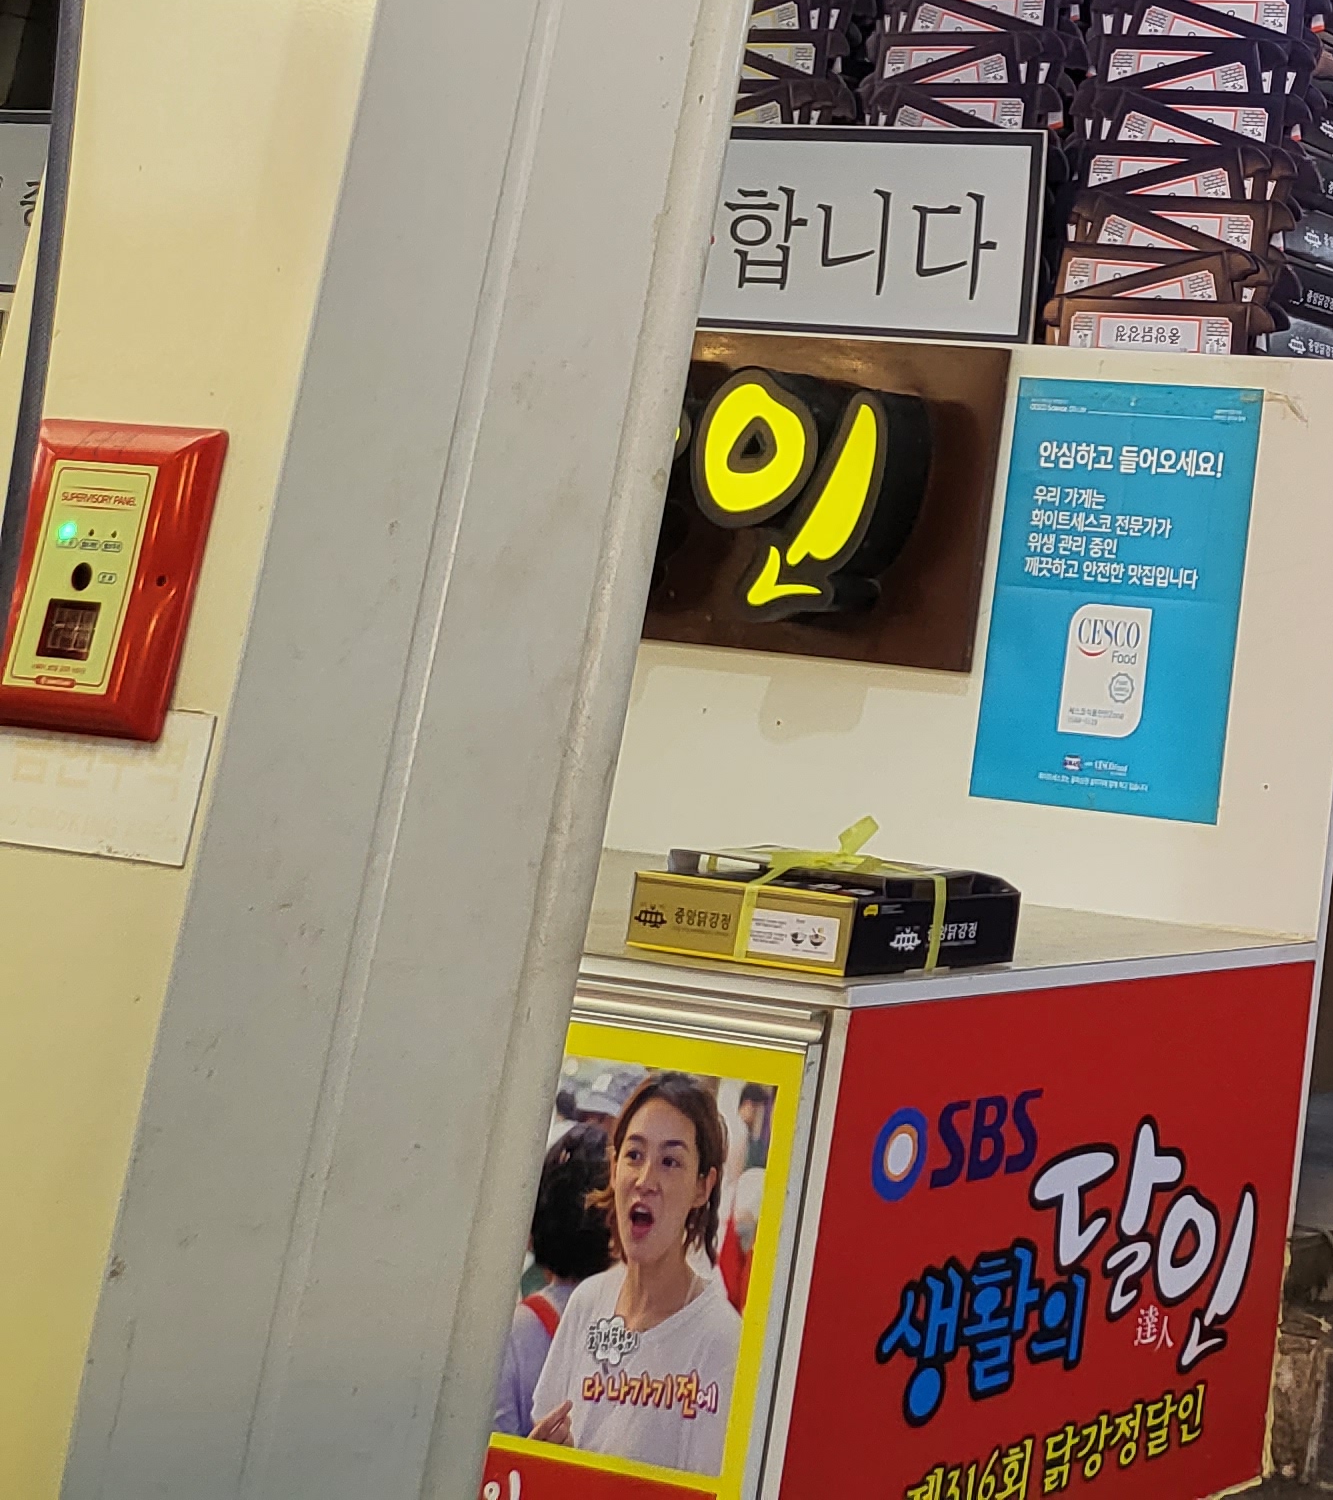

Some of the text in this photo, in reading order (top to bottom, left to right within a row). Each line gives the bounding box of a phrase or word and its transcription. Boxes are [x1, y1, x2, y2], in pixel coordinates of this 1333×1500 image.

[724, 184, 998, 300] 합니다
[1039, 441, 1224, 479] 안심하고 들어오세요!
[61, 491, 137, 507] SUPERVISORY PANEL
[1033, 485, 1106, 510] 우리 가게는
[1030, 509, 1172, 539] 화이트세스코 전문가가
[1028, 532, 1118, 559] 위생 관리 중인
[1024, 556, 1198, 590] 깨끗하고 안전한 맛집입니다
[1078, 617, 1141, 649] CESCO
[1111, 650, 1138, 665] Food
[930, 1089, 1043, 1189] SBS
[879, 1118, 1256, 1422] 생활의 달인
[582, 1371, 604, 1402] 다
[607, 1369, 673, 1410] 나가기
[1044, 1384, 1206, 1492] 닭강정달인
